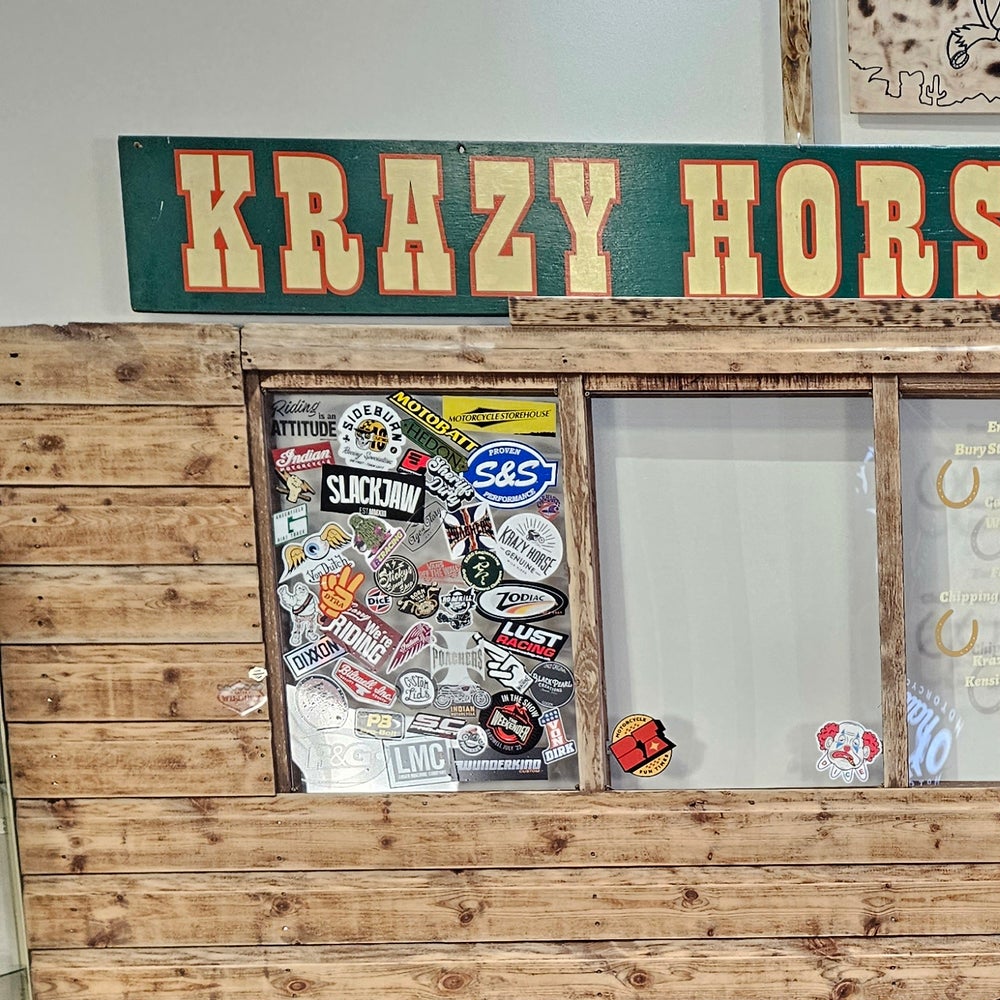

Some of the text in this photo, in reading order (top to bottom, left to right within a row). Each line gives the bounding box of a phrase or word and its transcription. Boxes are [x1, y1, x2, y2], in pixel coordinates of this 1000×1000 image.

[174, 149, 620, 297] KRAZY
[271, 399, 320, 418] Riding
[448, 410, 550, 423] MOTORCYCLE STOREHOUSE
[271, 420, 337, 437] ATTITUDE
[342, 405, 402, 442] SIDEBURN
[392, 391, 479, 452] MOTOBATT
[276, 448, 332, 467] Indian
[408, 423, 462, 469] HEDON
[488, 447, 521, 457] PROVEN
[954, 443, 987, 458] Bury
[473, 459, 541, 489] S&S
[326, 474, 422, 514] SLACKJAW
[483, 488, 536, 503] PERFORMANCE
[500, 525, 530, 553] KRAZY
[528, 547, 557, 576] HORSE
[505, 550, 536, 574] GENUINE
[496, 591, 546, 612] ZODIAC
[940, 590, 1000, 606] Chipping
[329, 614, 388, 665] RIDING
[364, 620, 394, 649] We're
[496, 634, 556, 658] RACING
[501, 621, 563, 647] LUST
[291, 640, 341, 671] DIXXON
[450, 705, 475, 714] INDIAN
[500, 693, 510, 703] IN
[510, 694, 523, 704] THE
[522, 698, 540, 718] SHOW
[366, 713, 393, 729] PB
[490, 709, 531, 742] WEEKENDER
[615, 717, 647, 738] MOTORCYCLE
[394, 742, 446, 774] LMC
[544, 742, 575, 762] DIRK
[655, 754, 669, 771] TIMES
[458, 759, 542, 772] WUNDERKIND
